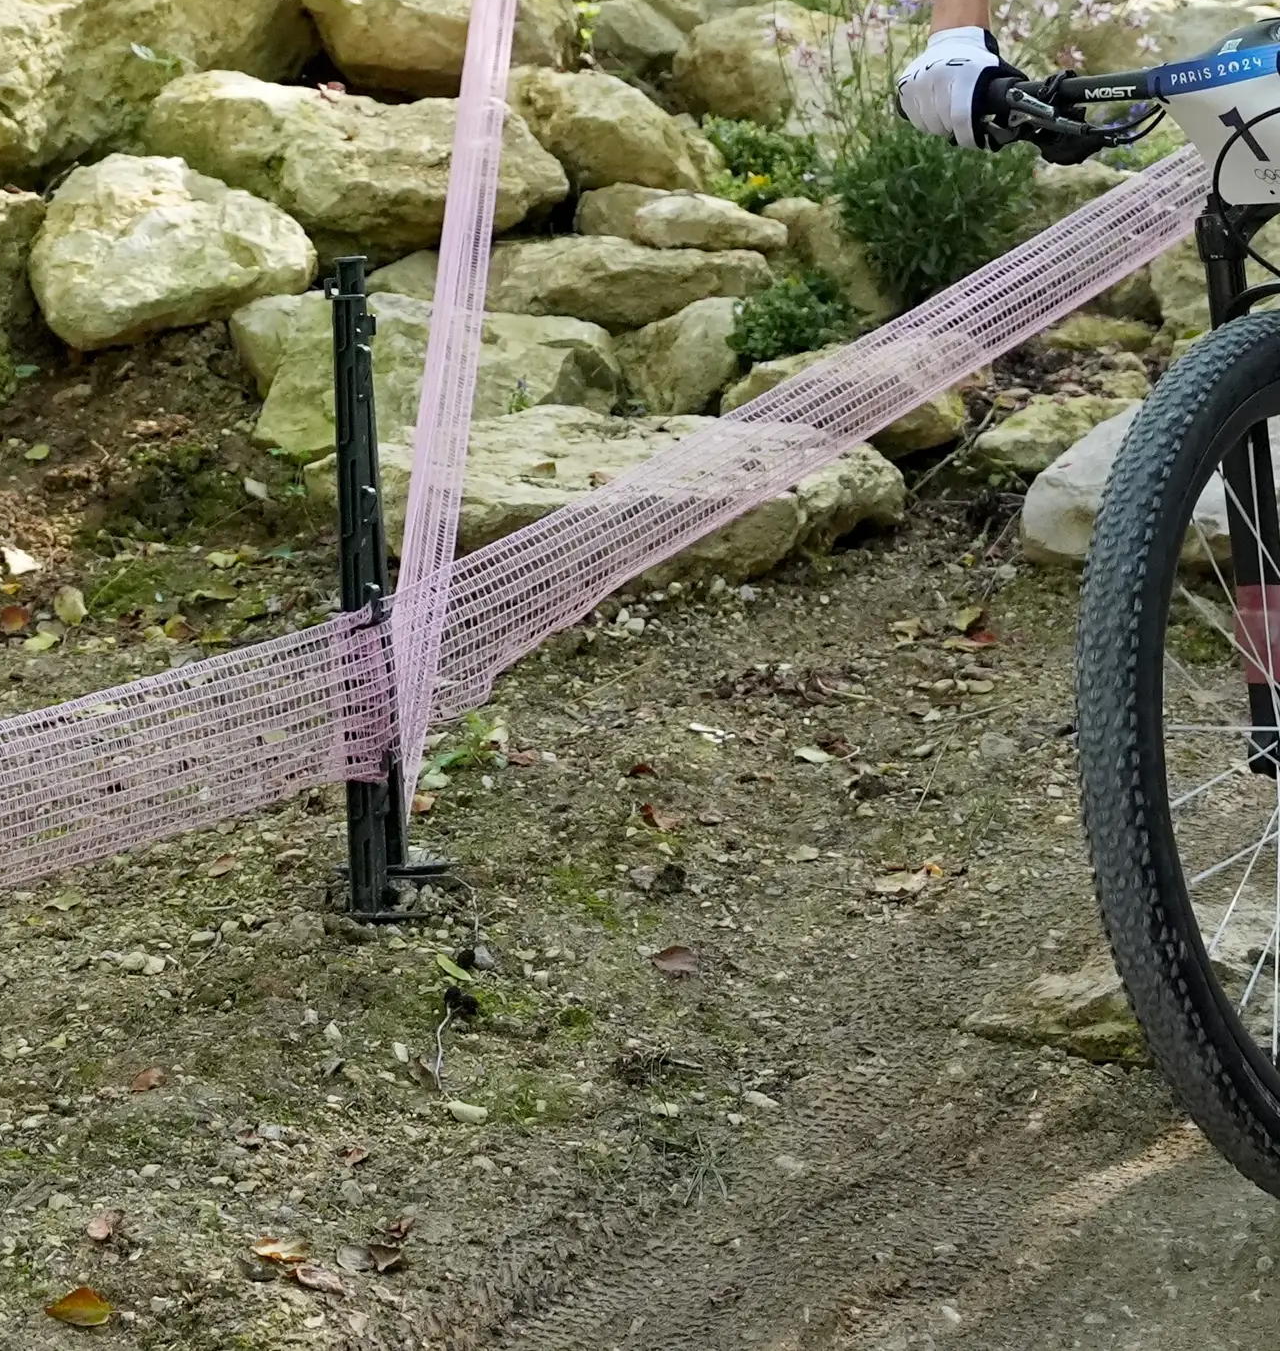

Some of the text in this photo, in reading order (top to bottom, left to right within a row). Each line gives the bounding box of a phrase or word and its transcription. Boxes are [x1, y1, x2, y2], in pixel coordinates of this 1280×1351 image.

[1171, 56, 1262, 86] PARIS 2024
[1218, 106, 1270, 162] 1
